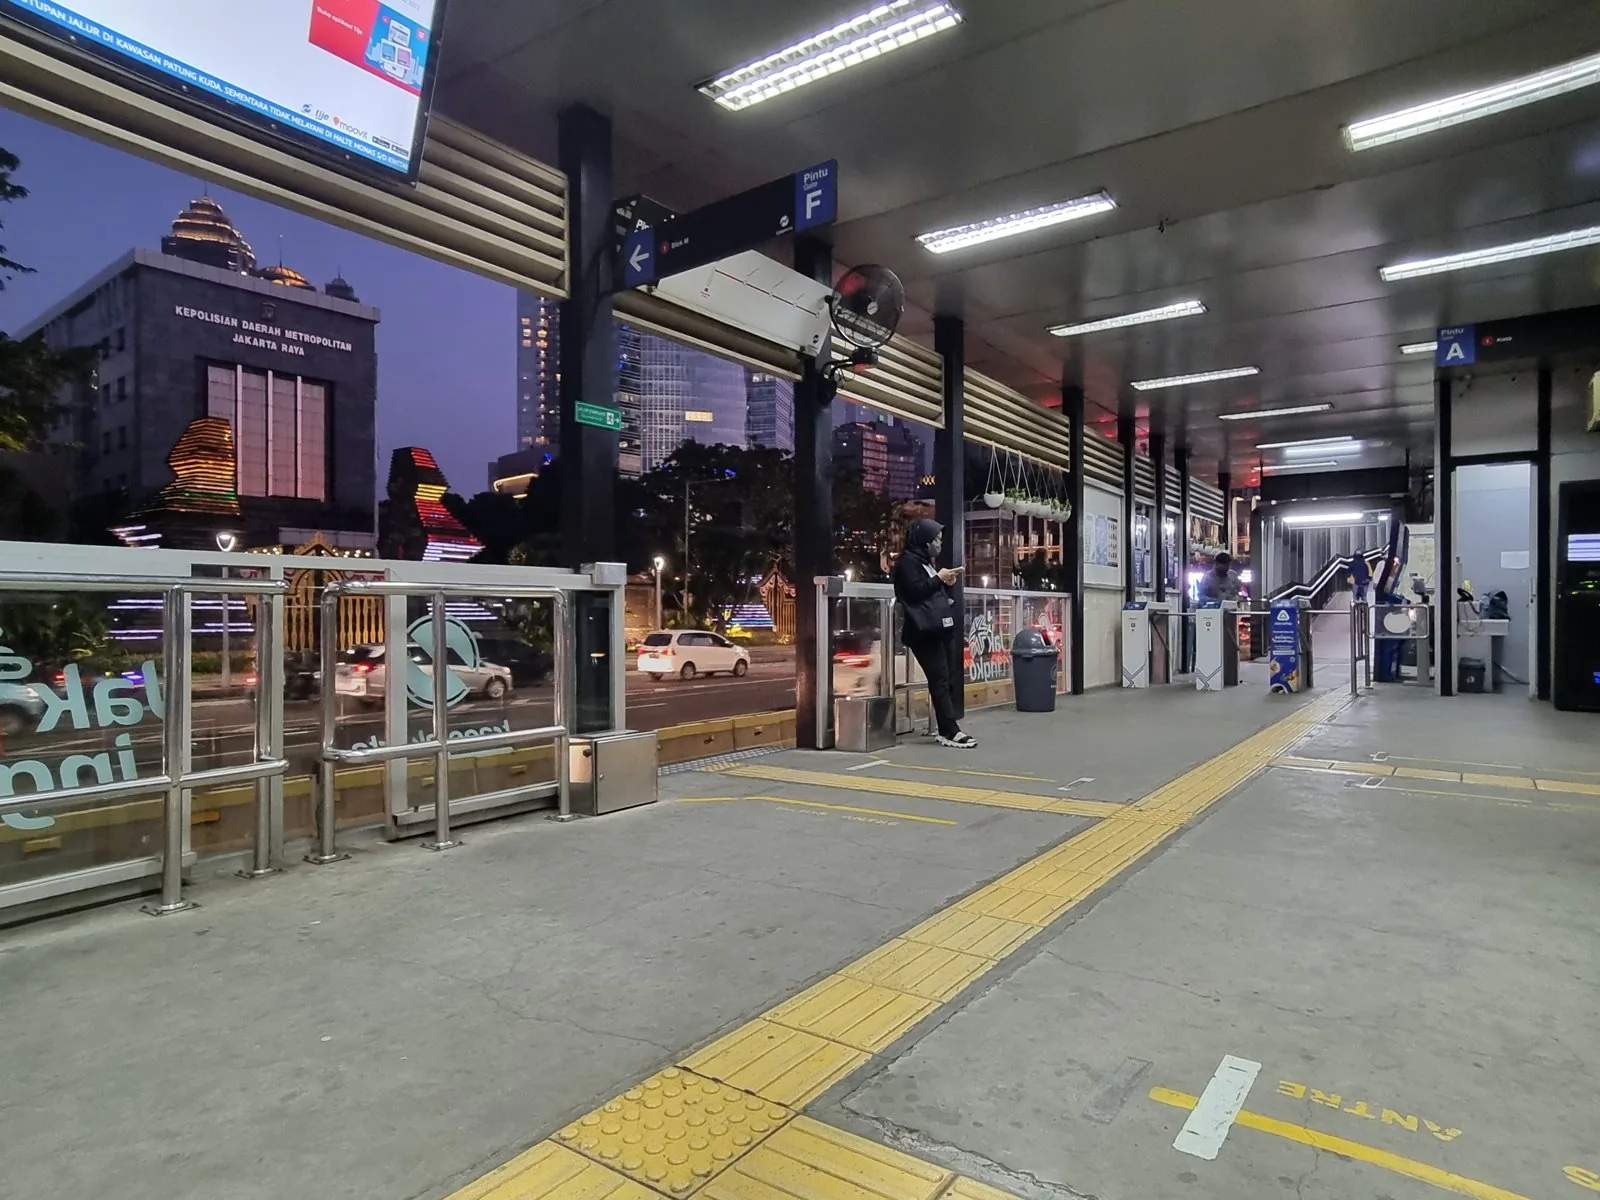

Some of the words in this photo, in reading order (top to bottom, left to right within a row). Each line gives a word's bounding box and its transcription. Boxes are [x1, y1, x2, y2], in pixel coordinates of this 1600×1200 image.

[68, 16, 100, 37] JALUR
[102, 31, 113, 43] DI
[115, 38, 162, 65] KAWASAN
[163, 59, 198, 80] PATUNG
[223, 86, 270, 113] SEMENTARA
[270, 105, 291, 121] TIDAK
[291, 115, 325, 137] MELAYANI
[325, 129, 333, 140] DI
[333, 132, 354, 148] HALTE
[354, 142, 377, 157] MONAS
[340, 121, 368, 139] moovit
[803, 168, 828, 184] Pintu
[806, 189, 822, 219] F
[175, 305, 238, 328] KEPOLISIAN
[242, 320, 281, 337] DAERAH
[284, 329, 352, 352] METROPOLITAN
[1441, 328, 1464, 336] Pintu
[232, 333, 277, 351] JAKARTA
[281, 343, 305, 357] RAYA
[1446, 342, 1465, 360] A
[1276, 1080, 1463, 1141] ANTRE
